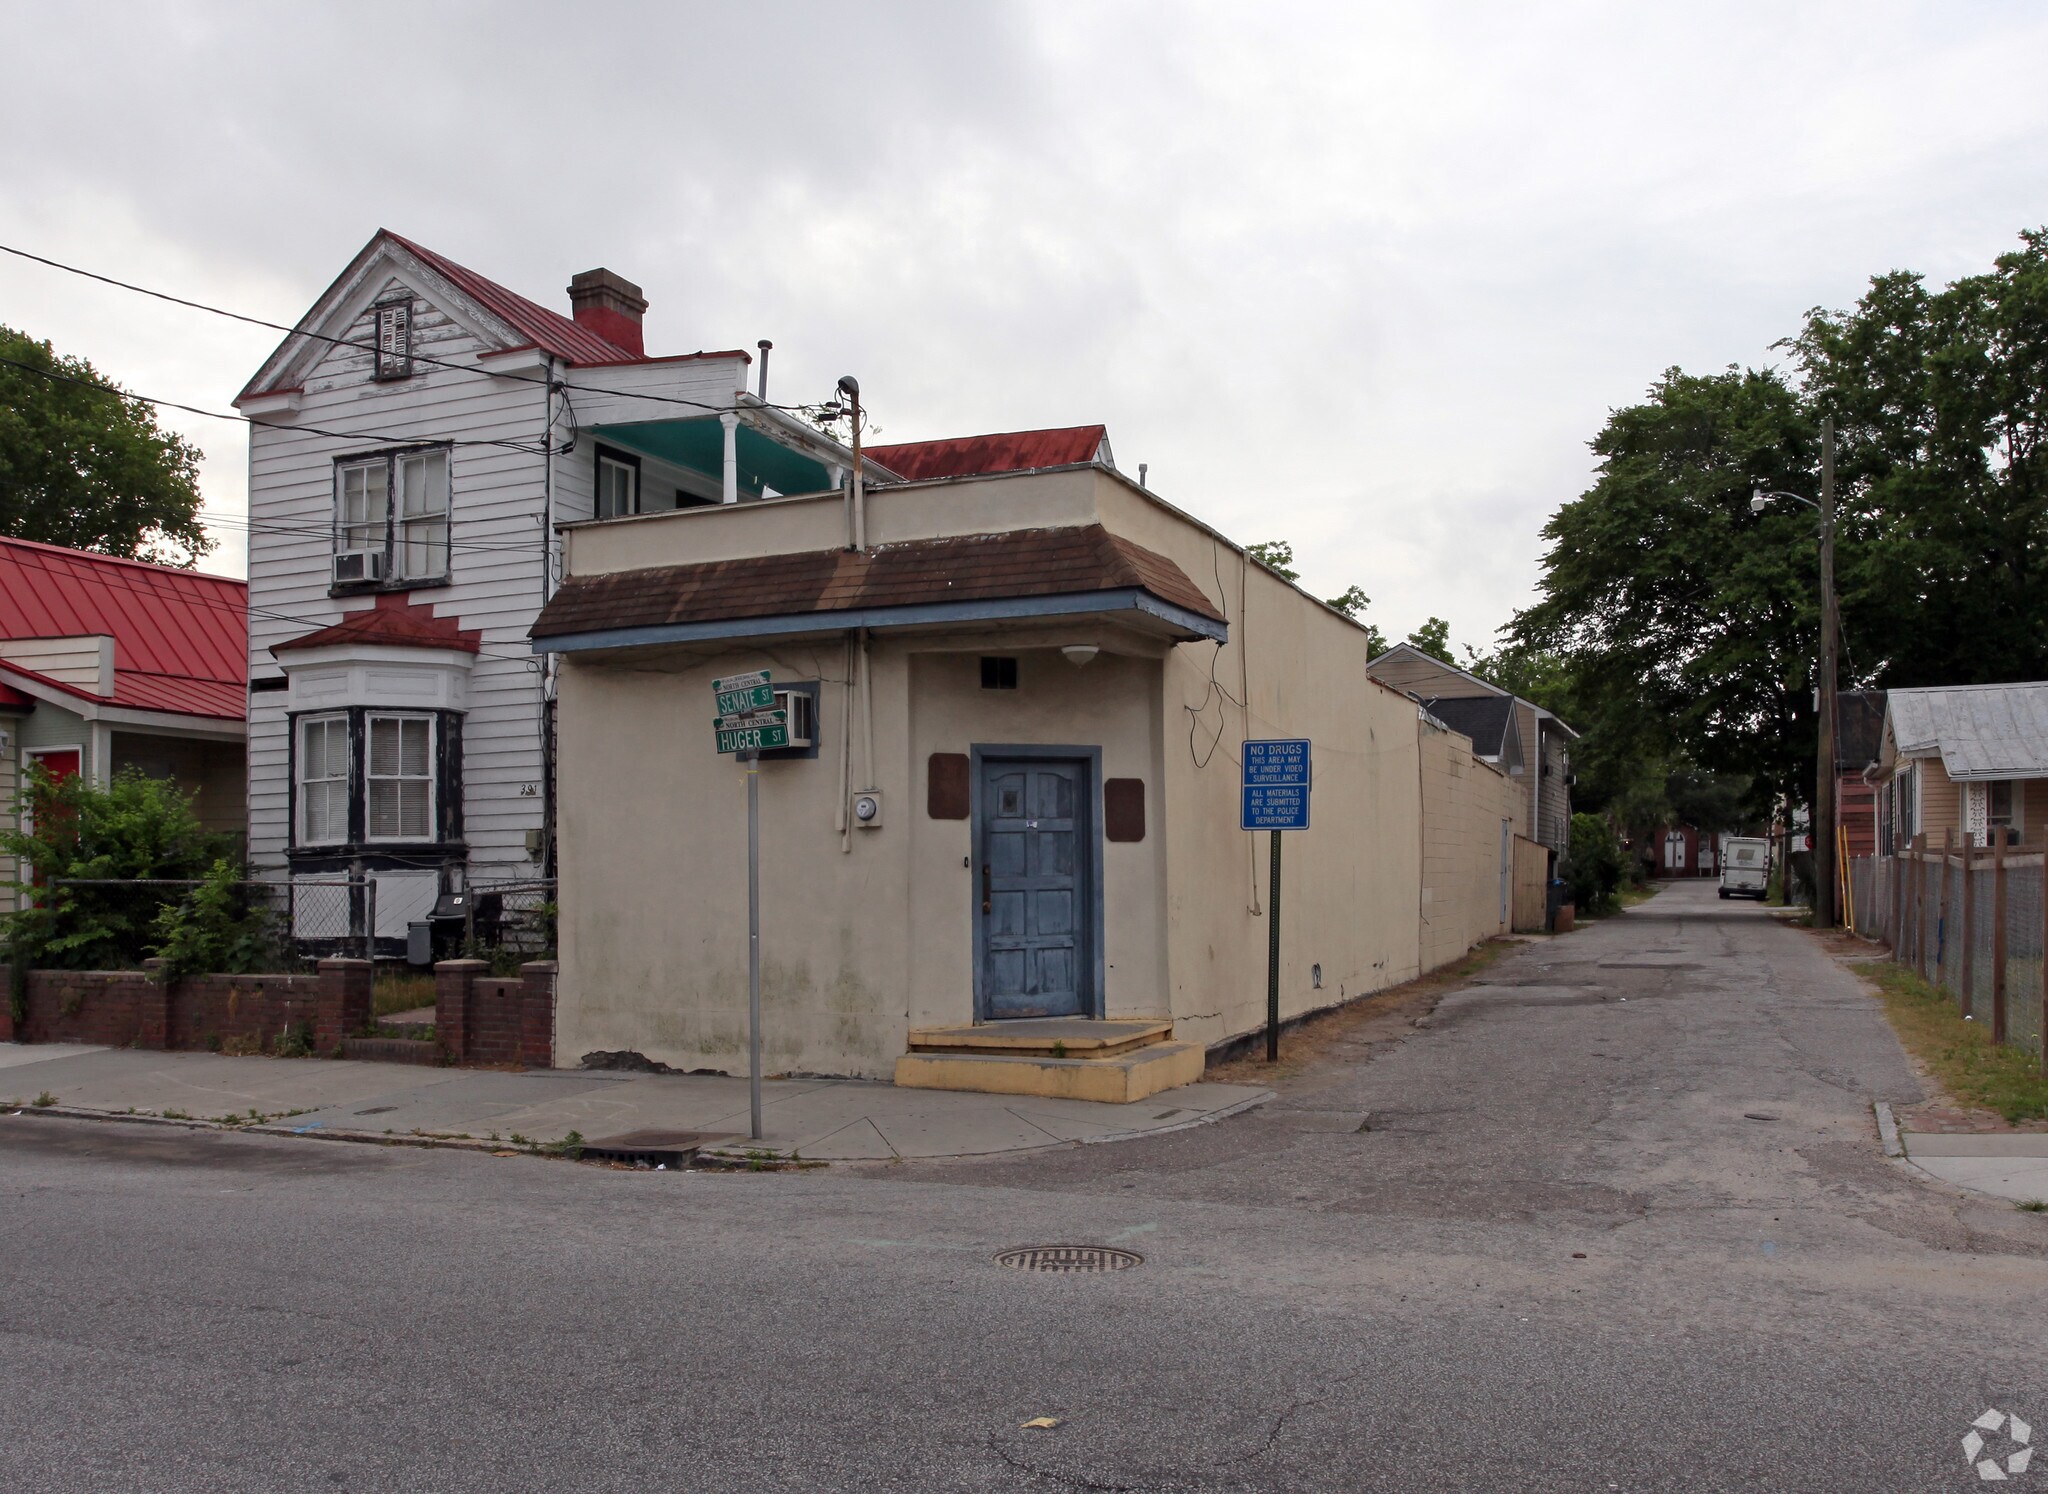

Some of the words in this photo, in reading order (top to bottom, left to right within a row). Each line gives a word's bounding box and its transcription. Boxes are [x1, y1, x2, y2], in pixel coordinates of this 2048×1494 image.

[723, 682, 740, 690] NORTH
[741, 678, 761, 687] CENTRAL
[720, 690, 757, 713] SENATE
[762, 689, 769, 701] ST
[748, 718, 773, 726] CENTRAL
[721, 730, 762, 750] HUGER
[772, 730, 781, 742] ST
[1250, 746, 1264, 755] NO
[1269, 745, 1302, 755] DRUGS
[1269, 756, 1285, 764] AREA
[1260, 765, 1281, 773] UNDER
[1284, 764, 1303, 772] VIDEO
[1253, 774, 1298, 782] SURVEILLANCE
[1252, 789, 1263, 797] ALL
[1267, 789, 1299, 797] MATERIALS
[1266, 798, 1300, 806] SUBMITTED
[1251, 807, 1260, 815] TO
[1263, 807, 1274, 815] THE
[1256, 816, 1294, 824] DEPARTMENT
